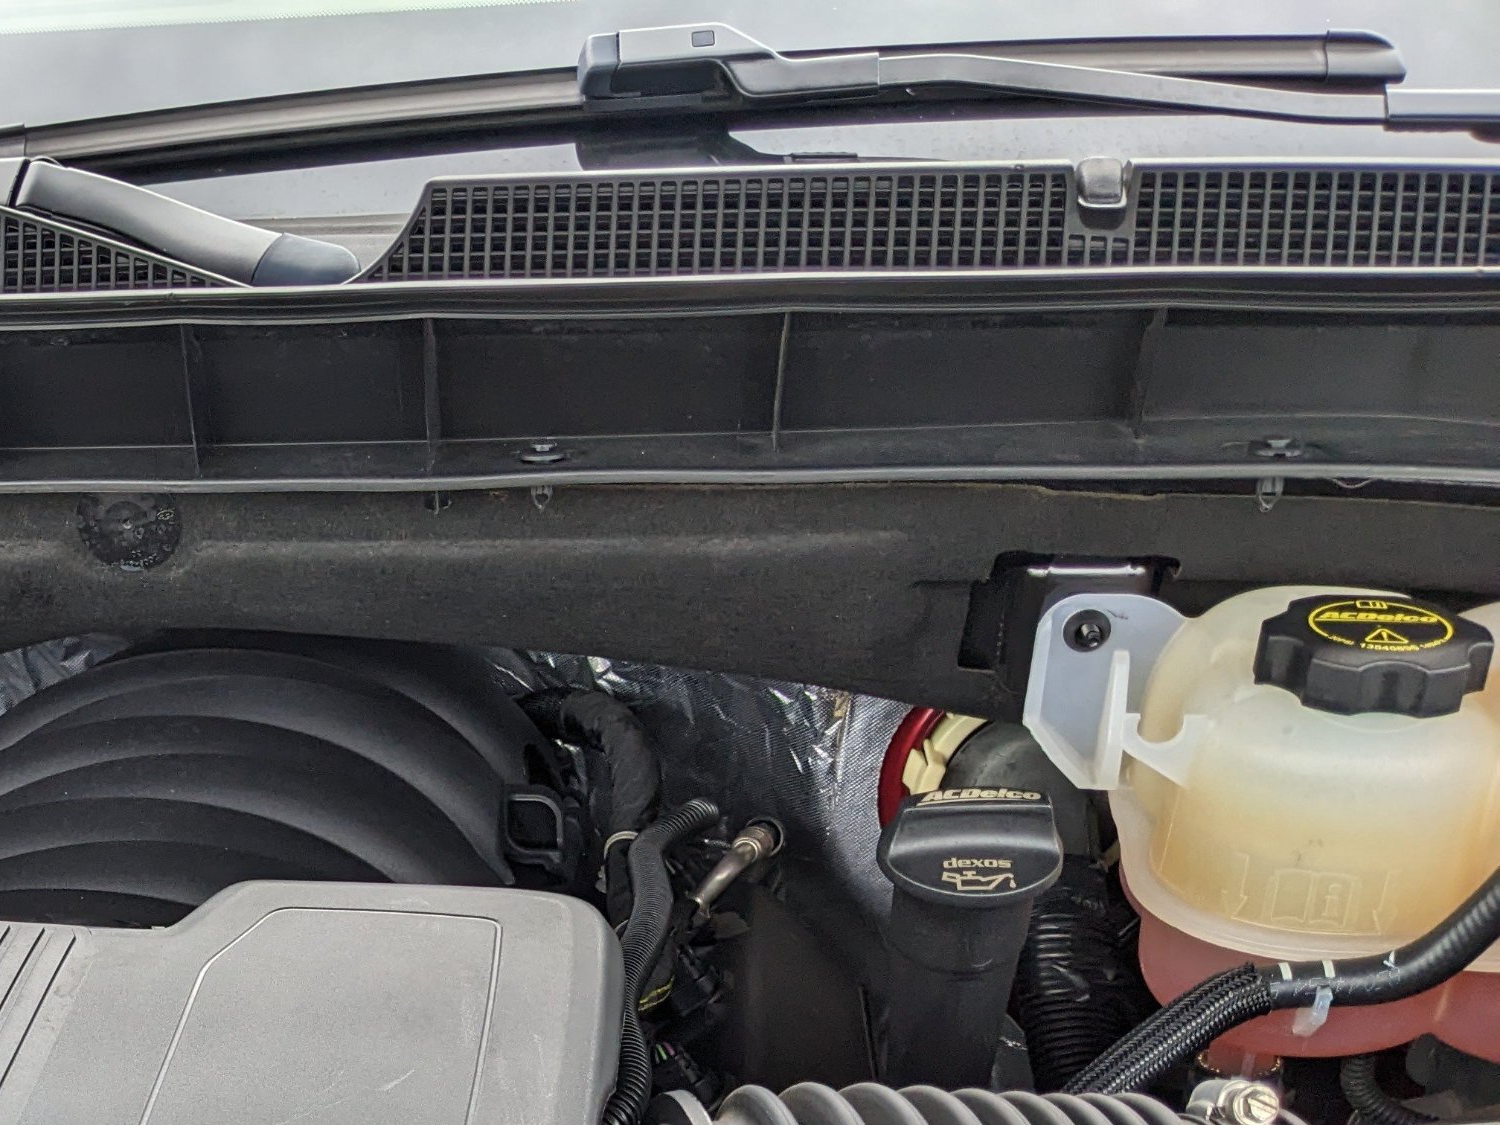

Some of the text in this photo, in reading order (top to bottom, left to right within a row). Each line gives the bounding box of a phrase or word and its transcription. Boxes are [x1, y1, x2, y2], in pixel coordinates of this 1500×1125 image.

[1315, 611, 1438, 622] ACDelco
[918, 788, 1042, 804] ACDelco
[942, 857, 1012, 869] dexos
